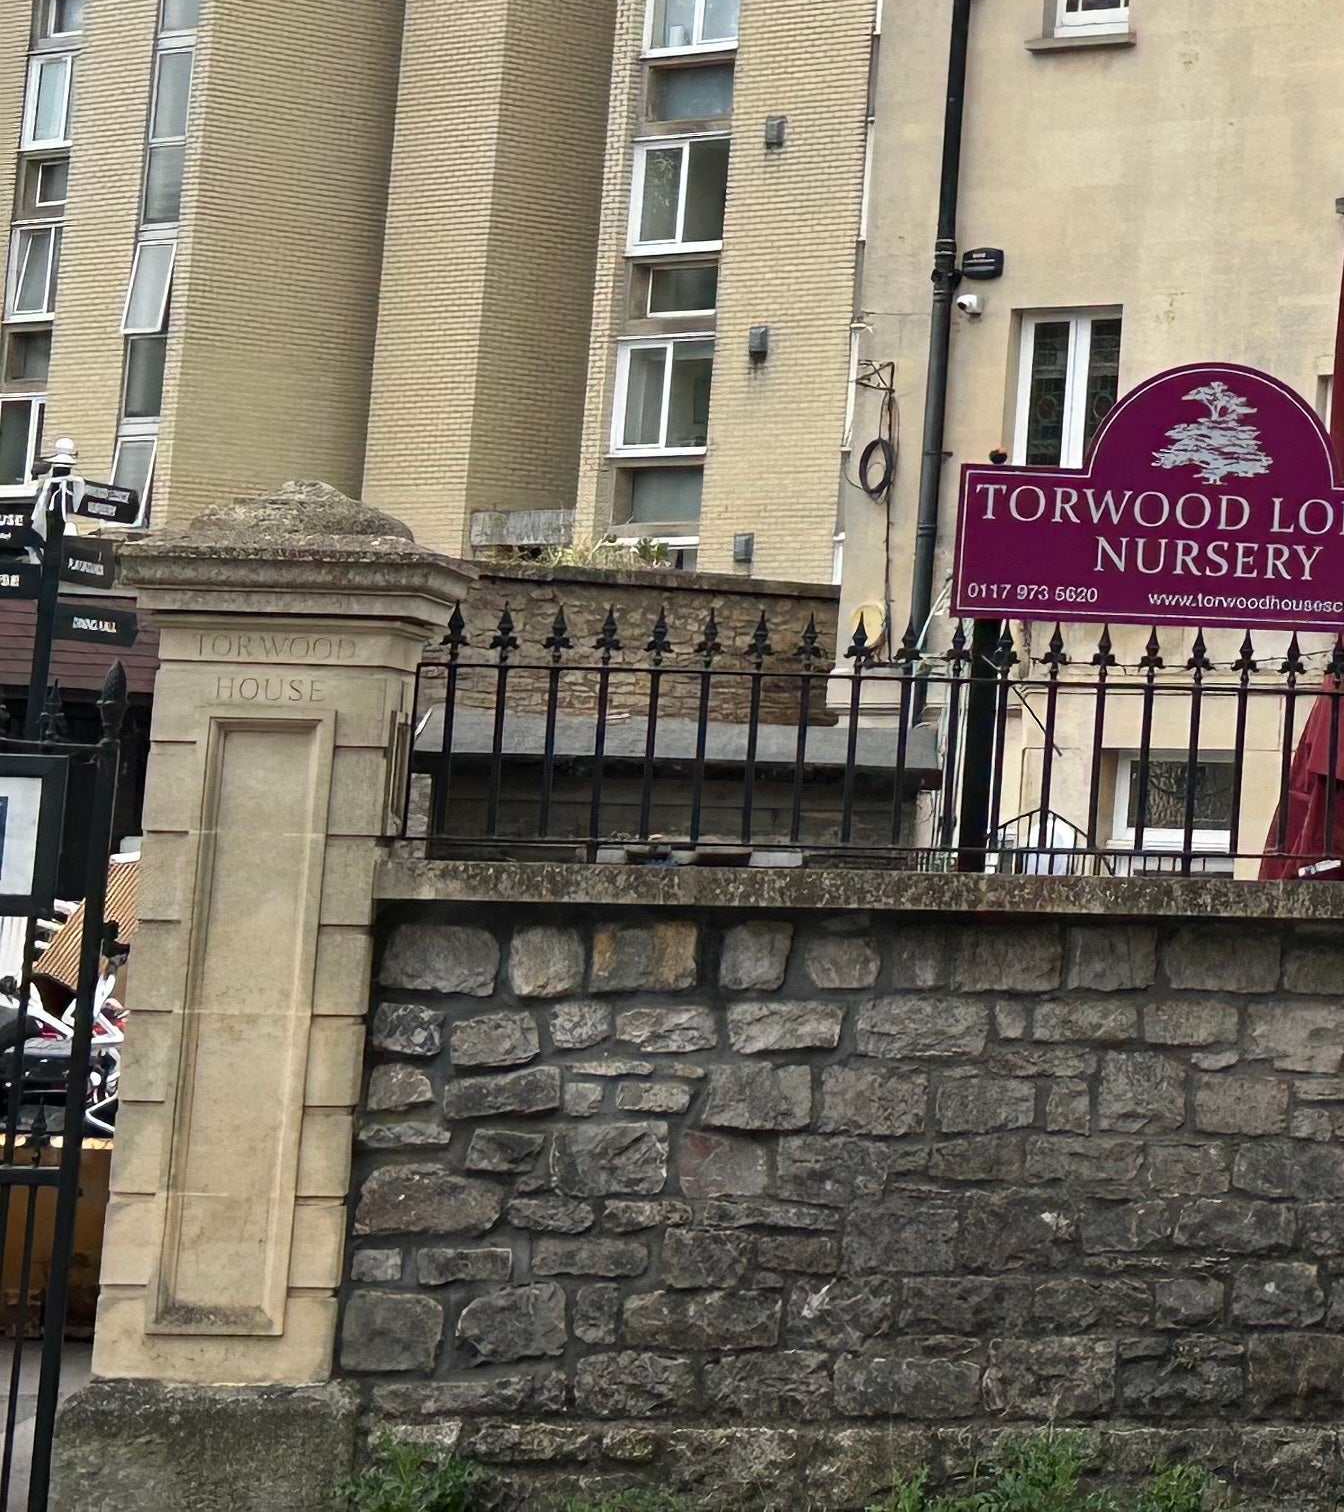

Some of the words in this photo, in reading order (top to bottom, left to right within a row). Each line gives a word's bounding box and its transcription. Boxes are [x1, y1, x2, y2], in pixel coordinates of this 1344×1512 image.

[976, 484, 1251, 530] TORWOOD
[1093, 536, 1324, 581] NURSERY
[967, 582, 1012, 600] 0117
[1016, 584, 1049, 601] 973
[193, 633, 357, 661] TORWOOD
[216, 676, 326, 703] HOUSE
